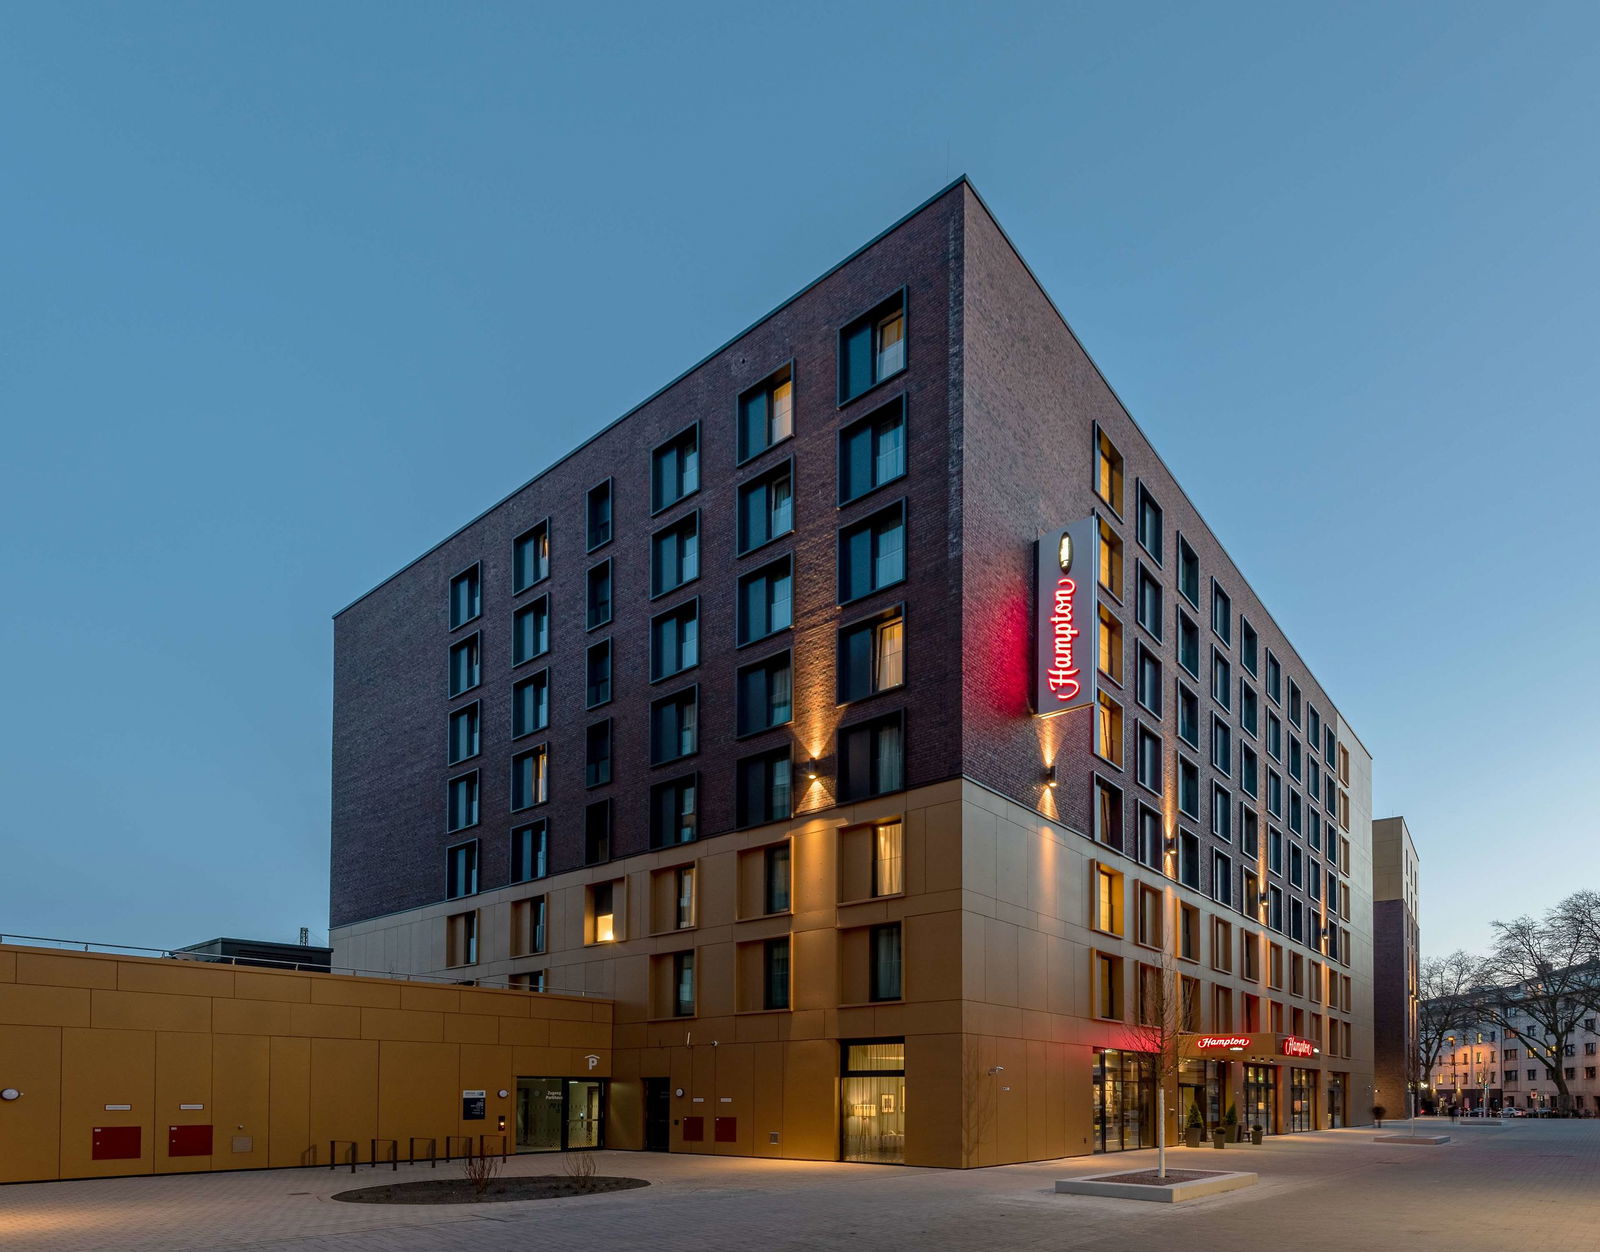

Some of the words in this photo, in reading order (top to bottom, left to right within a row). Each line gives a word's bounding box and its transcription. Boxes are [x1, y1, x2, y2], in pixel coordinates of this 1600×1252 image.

[1047, 578, 1080, 700] Hampton
[1197, 1037, 1250, 1048] Hampton
[1285, 1036, 1313, 1057] Hampton
[588, 1057, 598, 1071] P
